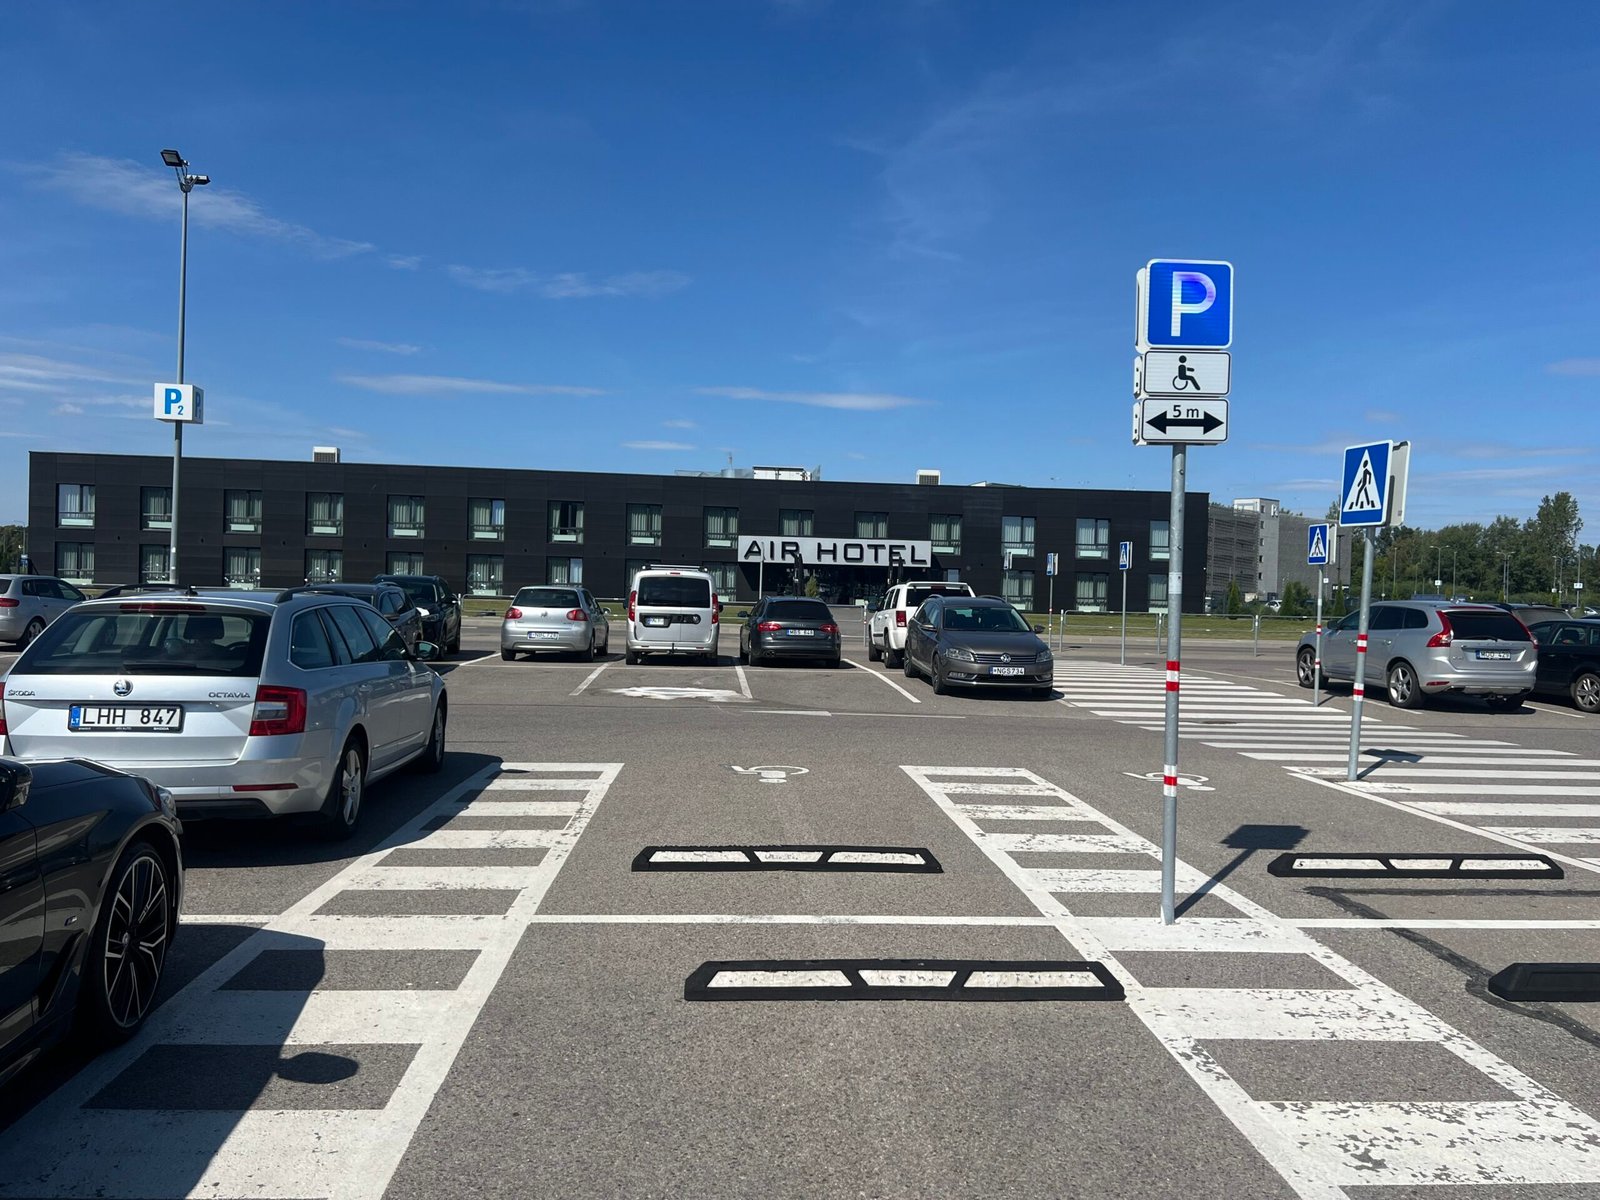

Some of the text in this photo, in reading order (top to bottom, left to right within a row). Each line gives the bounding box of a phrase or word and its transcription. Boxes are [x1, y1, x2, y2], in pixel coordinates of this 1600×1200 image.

[1171, 271, 1216, 336] P
[1173, 405, 1199, 418] 5 m
[743, 541, 927, 564] AIR HOTEL
[82, 708, 177, 725] LHH 847
